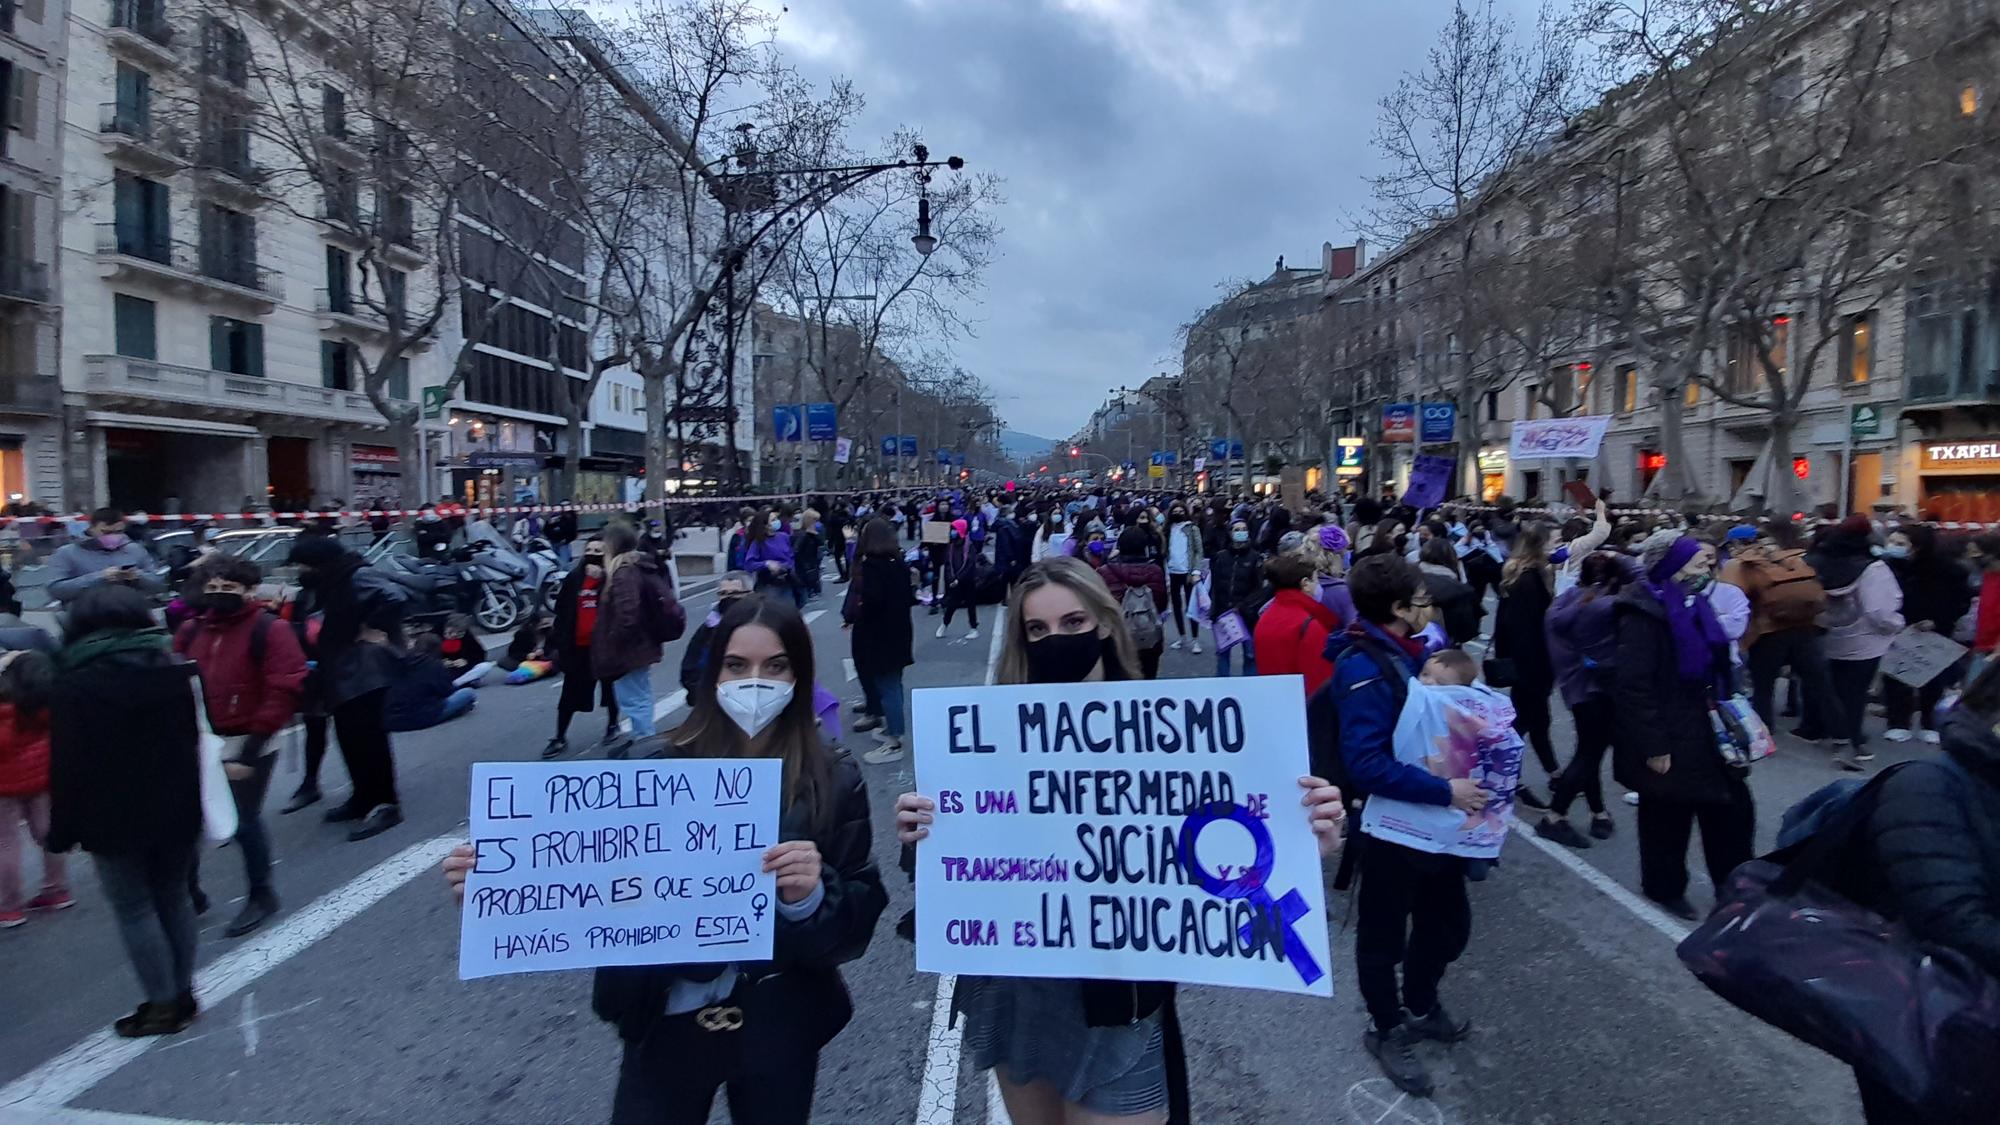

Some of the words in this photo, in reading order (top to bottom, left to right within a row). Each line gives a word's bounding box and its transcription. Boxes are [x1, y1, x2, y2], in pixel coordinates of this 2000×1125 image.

[1344, 446, 1356, 459] P
[948, 703, 996, 754] EL
[487, 777, 532, 819] EL
[545, 769, 695, 814] PROBLEMA
[714, 766, 752, 802] NO
[939, 790, 964, 814] ES
[975, 789, 1019, 815] UNA
[1028, 769, 1235, 816] ENFERMEDAD
[1246, 793, 1269, 819] DE
[473, 837, 519, 874] ES
[532, 824, 639, 868] PROHIBIR
[644, 822, 671, 853] EL
[685, 821, 722, 855] 8M,
[734, 823, 766, 851] EL
[471, 883, 604, 918] PROBLEMA
[611, 877, 643, 902] ES
[654, 875, 693, 902] QUE
[703, 872, 756, 898] SOLO
[946, 919, 999, 946] CURA
[1013, 920, 1039, 947] ES
[1041, 892, 1076, 948] LA
[493, 928, 570, 960] HAYÁIS
[584, 923, 681, 949] PROHIBIDO
